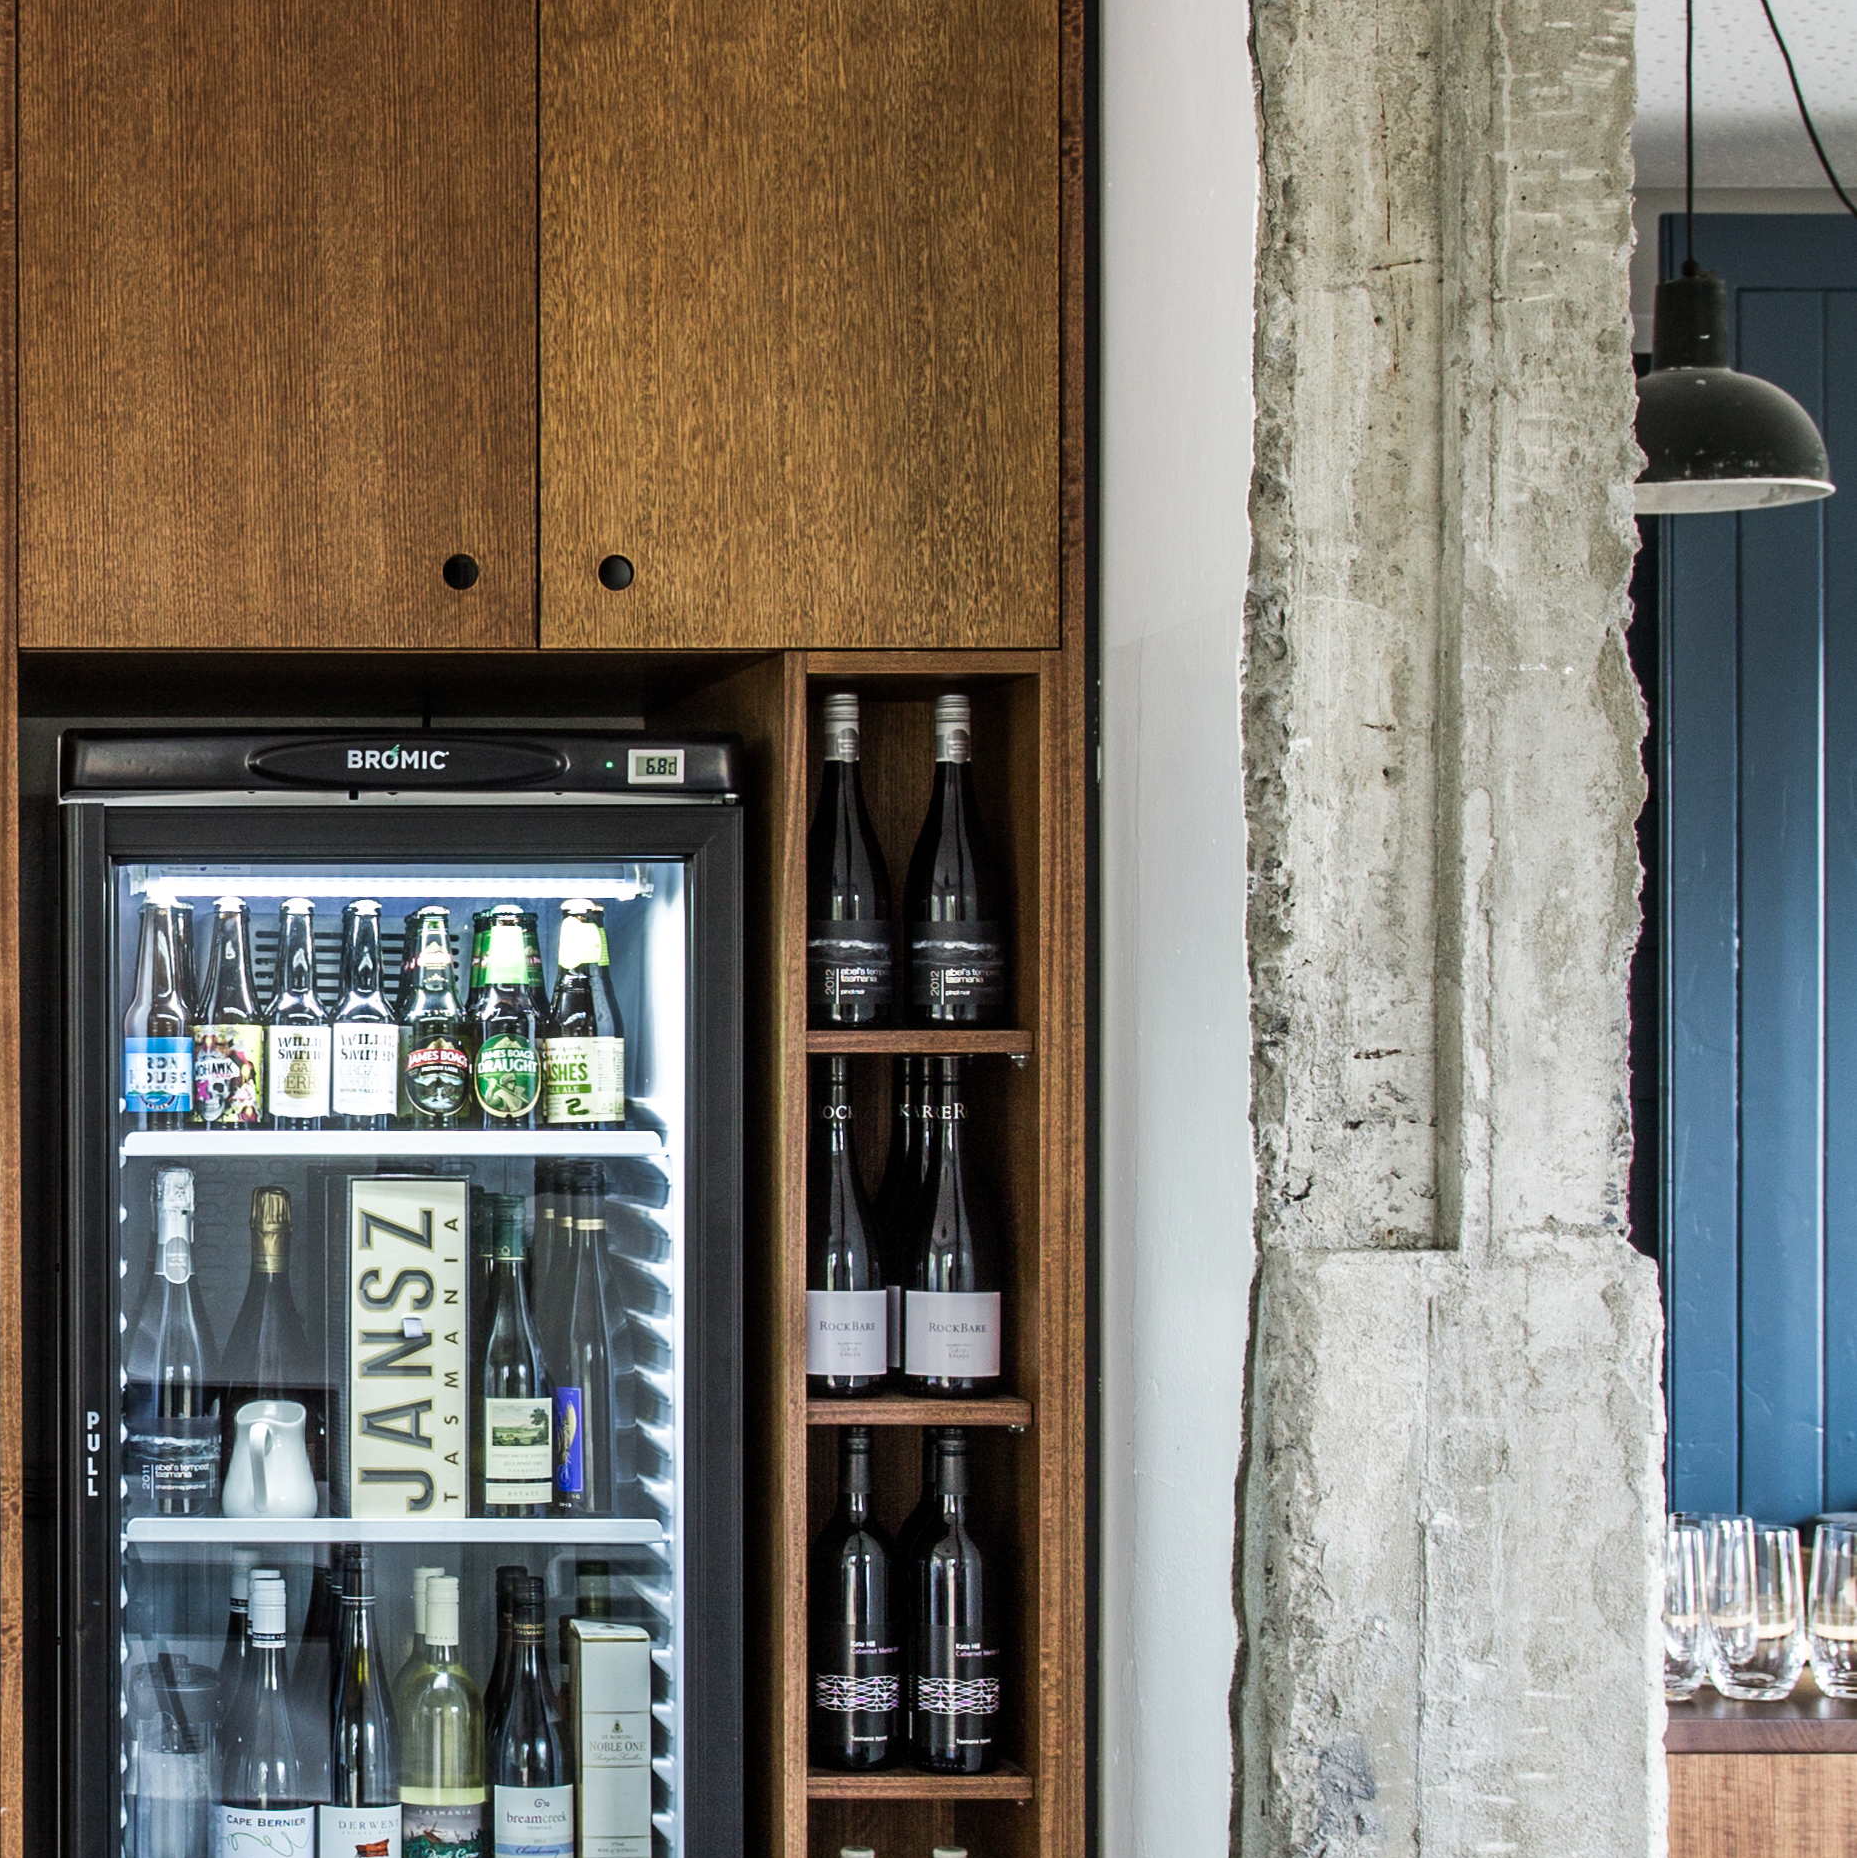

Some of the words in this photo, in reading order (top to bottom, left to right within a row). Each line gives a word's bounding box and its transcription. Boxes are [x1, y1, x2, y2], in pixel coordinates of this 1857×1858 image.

[347, 749, 447, 770] BROMIC
[825, 969, 835, 995] 2012
[930, 970, 940, 996] 2012
[408, 1049, 440, 1067] JAMES
[481, 1050, 506, 1061] JAMES
[478, 1059, 538, 1073] DRAUGHT
[357, 1207, 438, 1514] JANSZ
[444, 1216, 459, 1504] TASMANIA
[87, 1411, 100, 1496] PULL
[142, 1464, 151, 1490] 2011
[589, 1741, 622, 1752] NOBLE
[624, 1741, 646, 1751] ONE
[227, 1814, 253, 1827] CAPE
[258, 1817, 306, 1828] BERNIER
[418, 1809, 472, 1817] TASMANIA
[507, 1811, 567, 1823] breamcreek
[339, 1818, 399, 1830] DERWENT
